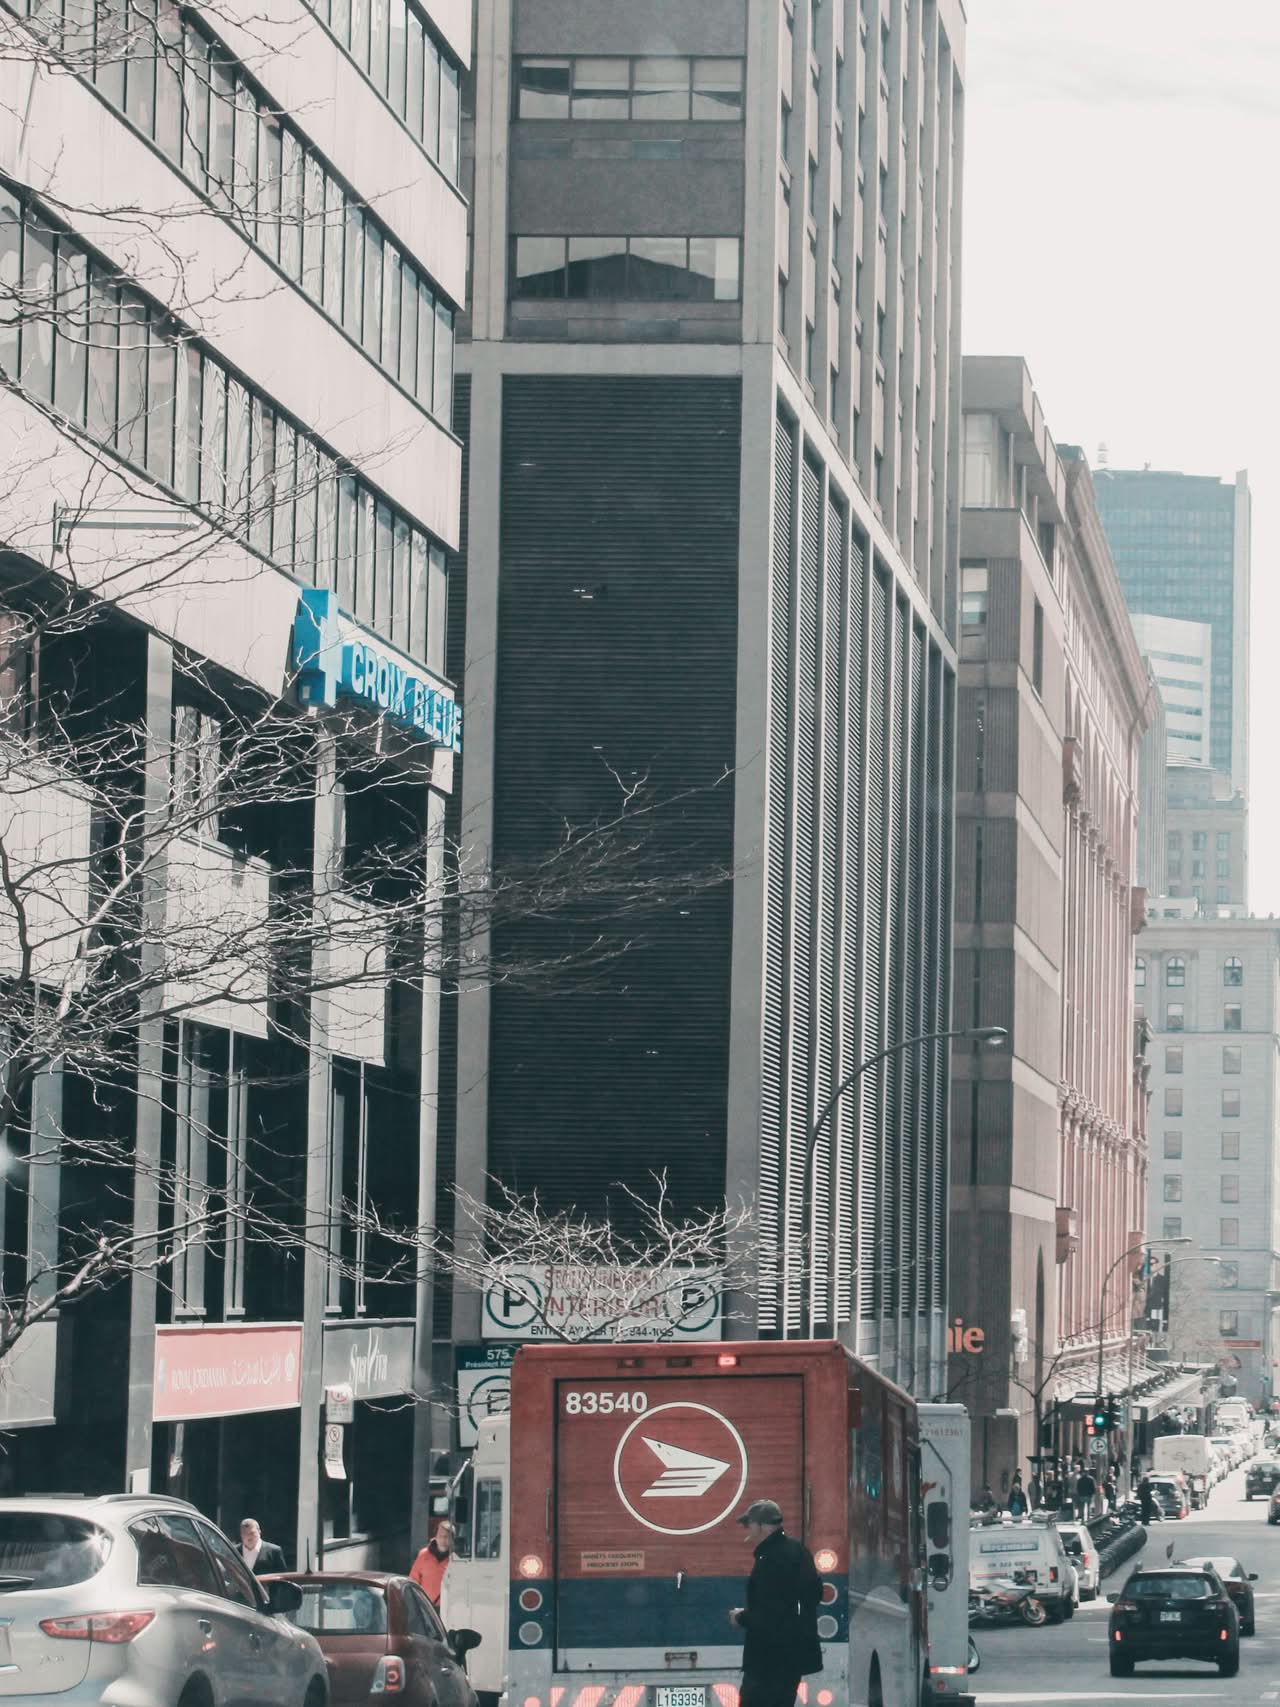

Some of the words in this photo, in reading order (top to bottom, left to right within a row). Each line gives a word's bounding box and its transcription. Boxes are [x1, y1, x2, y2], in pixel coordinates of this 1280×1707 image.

[352, 641, 407, 718] CROIX
[413, 678, 462, 754] BLEUE
[487, 1349, 511, 1360] 575
[566, 1392, 647, 1414] 83540
